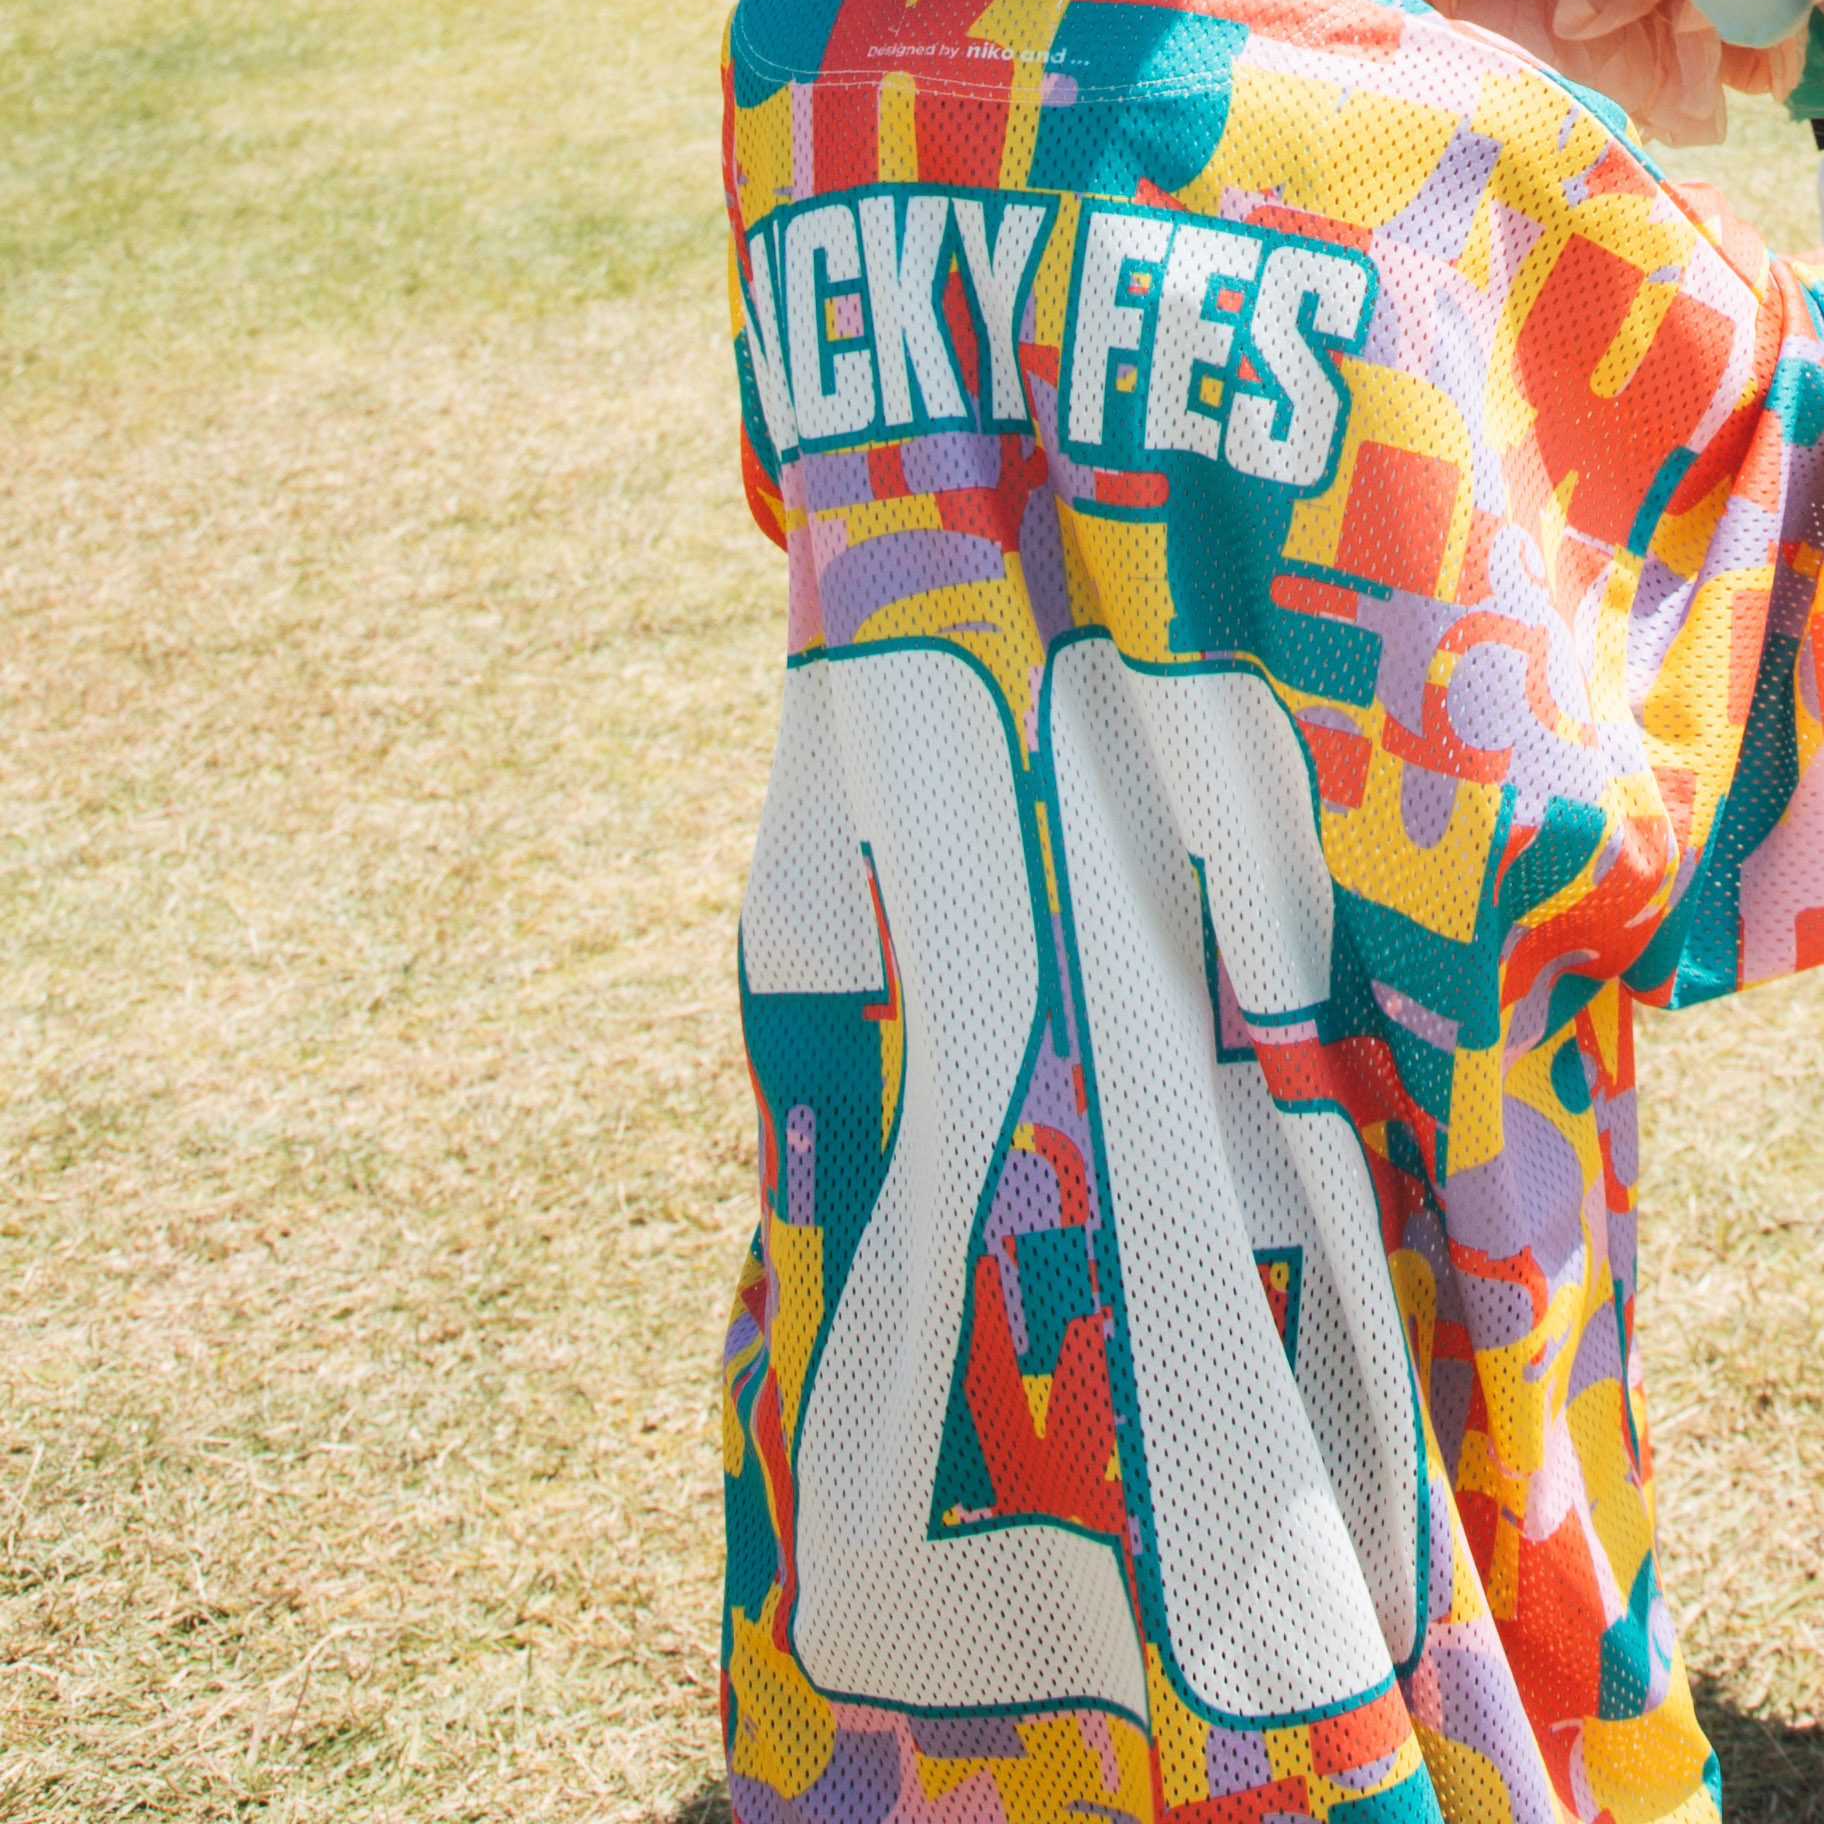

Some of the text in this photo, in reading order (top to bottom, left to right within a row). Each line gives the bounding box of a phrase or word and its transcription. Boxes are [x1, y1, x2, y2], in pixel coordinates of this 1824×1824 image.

[938, 43, 960, 59] by
[966, 41, 1014, 61] niko
[1020, 47, 1067, 64] and
[1067, 211, 1368, 487] FES
